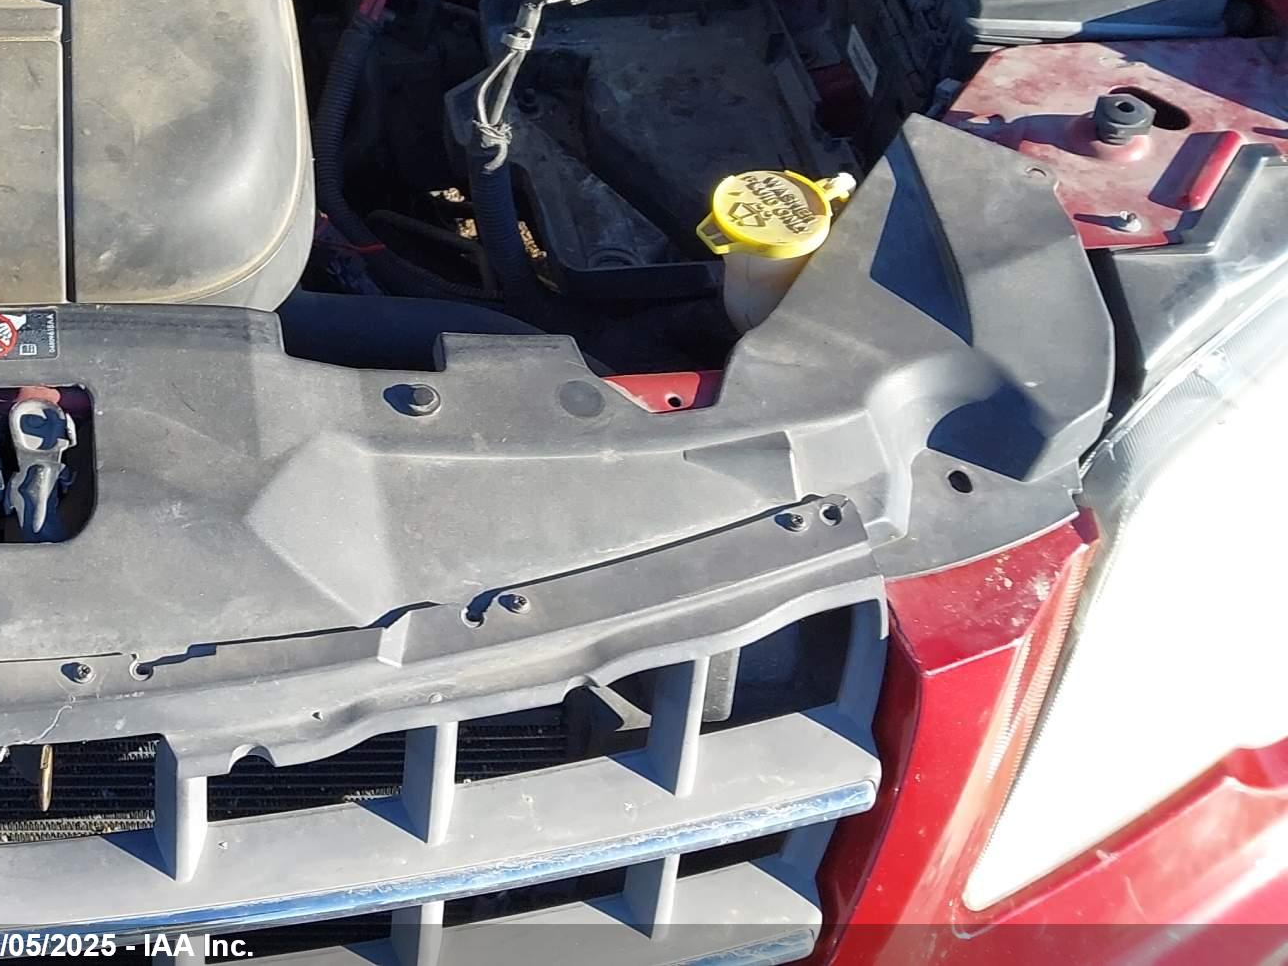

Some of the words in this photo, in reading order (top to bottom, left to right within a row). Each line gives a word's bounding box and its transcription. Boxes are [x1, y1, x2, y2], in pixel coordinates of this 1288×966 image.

[741, 175, 779, 206] FLUID
[772, 206, 811, 235] ONLY
[763, 176, 819, 225] WASHER
